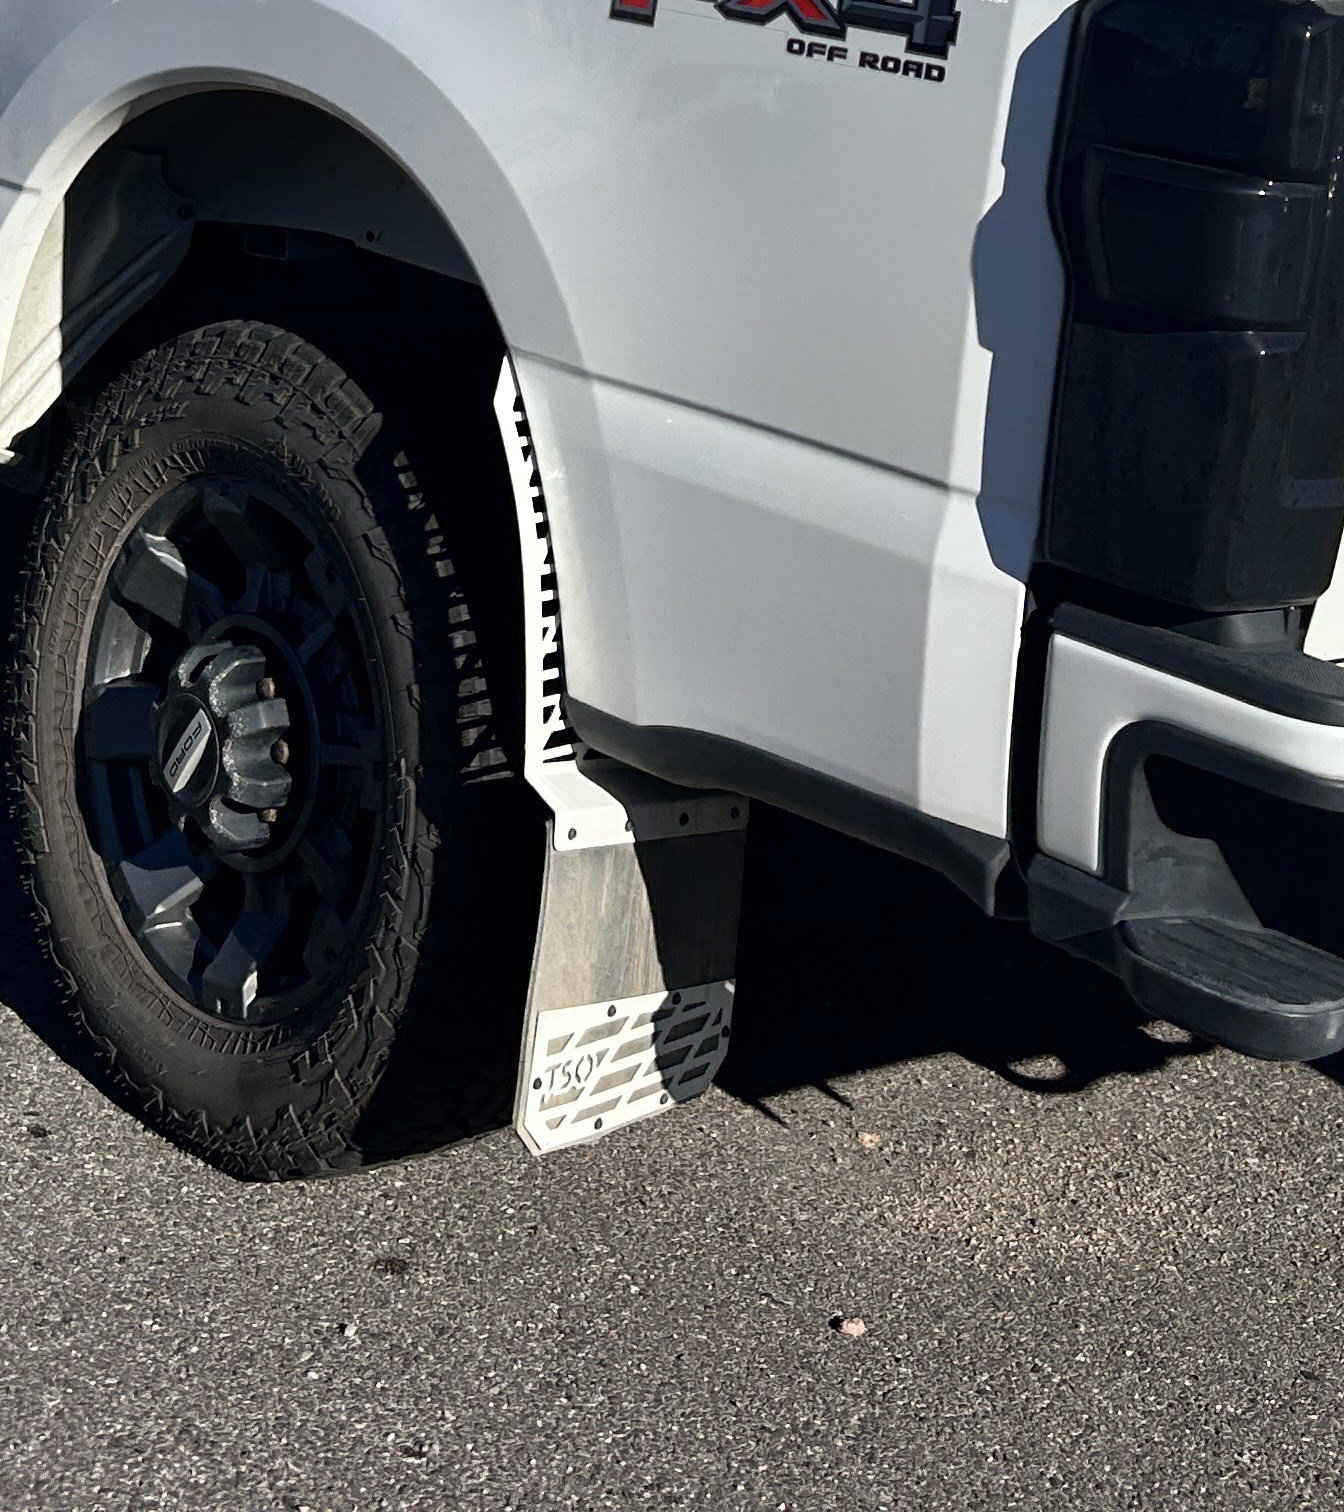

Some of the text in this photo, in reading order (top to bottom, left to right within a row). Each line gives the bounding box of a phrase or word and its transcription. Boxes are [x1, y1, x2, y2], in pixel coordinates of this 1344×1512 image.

[786, 37, 946, 83] OFF ROAD
[168, 721, 203, 778] FORD
